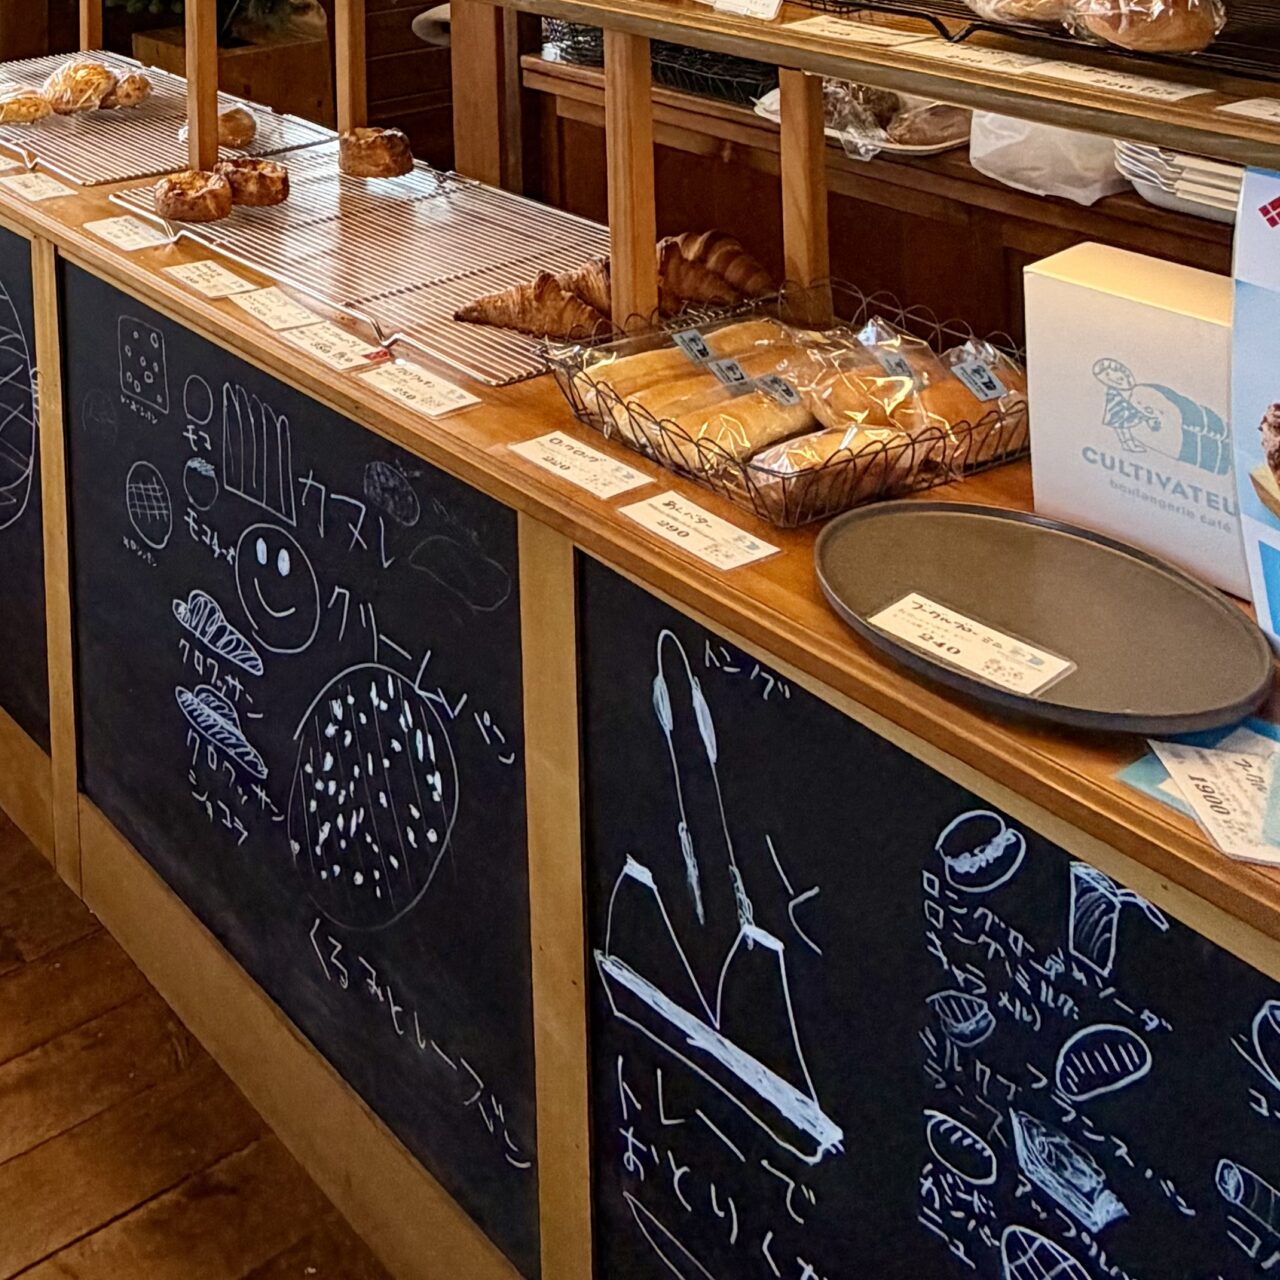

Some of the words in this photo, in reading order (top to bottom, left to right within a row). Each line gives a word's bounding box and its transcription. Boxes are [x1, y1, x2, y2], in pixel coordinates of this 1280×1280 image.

[392, 386, 417, 400] 250
[183, 424, 212, 452] モコ
[542, 454, 571, 471] 220
[1081, 445, 1239, 517] CULTIVATEU
[298, 469, 394, 569] カヌレ
[656, 519, 690, 538] 290
[917, 631, 961, 656] 240
[704, 638, 791, 700] トング
[1187, 773, 1231, 816] 1900
[617, 1055, 817, 1225] トレーで
